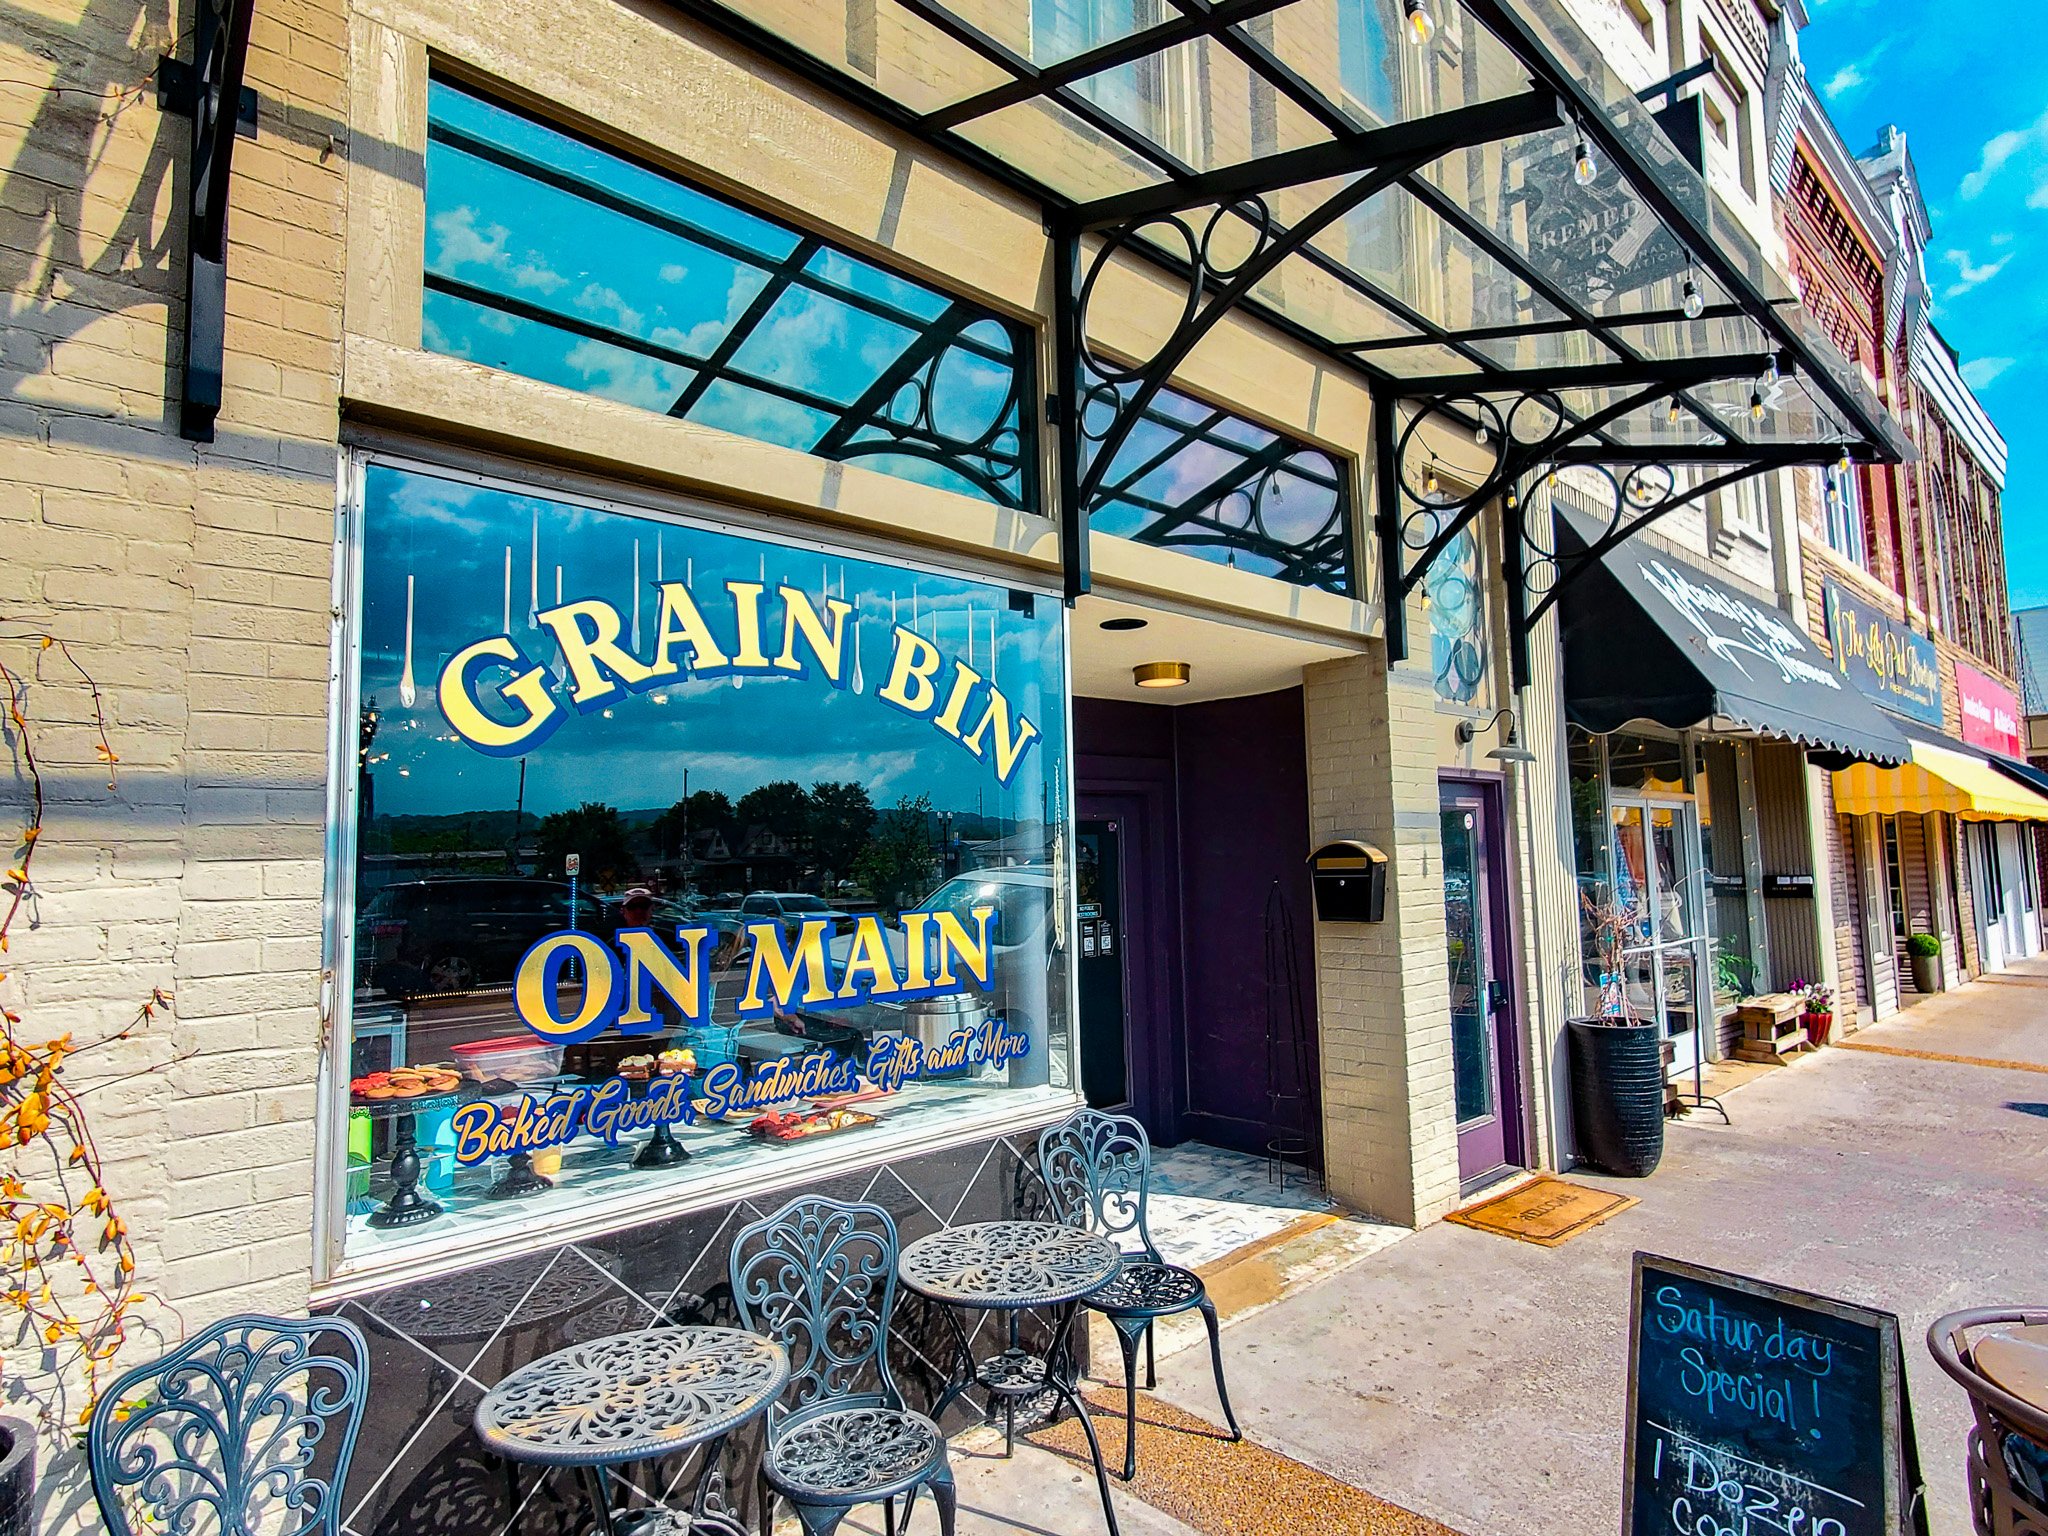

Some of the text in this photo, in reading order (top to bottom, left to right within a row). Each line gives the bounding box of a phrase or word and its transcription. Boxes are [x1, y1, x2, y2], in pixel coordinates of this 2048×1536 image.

[438, 578, 1042, 787] GRAIN BIN
[514, 906, 997, 1043] ON MAIN
[451, 1018, 1030, 1165] Baked Goods, Sandwiches, Gifts and More
[1656, 1286, 1832, 1377] Saturday
